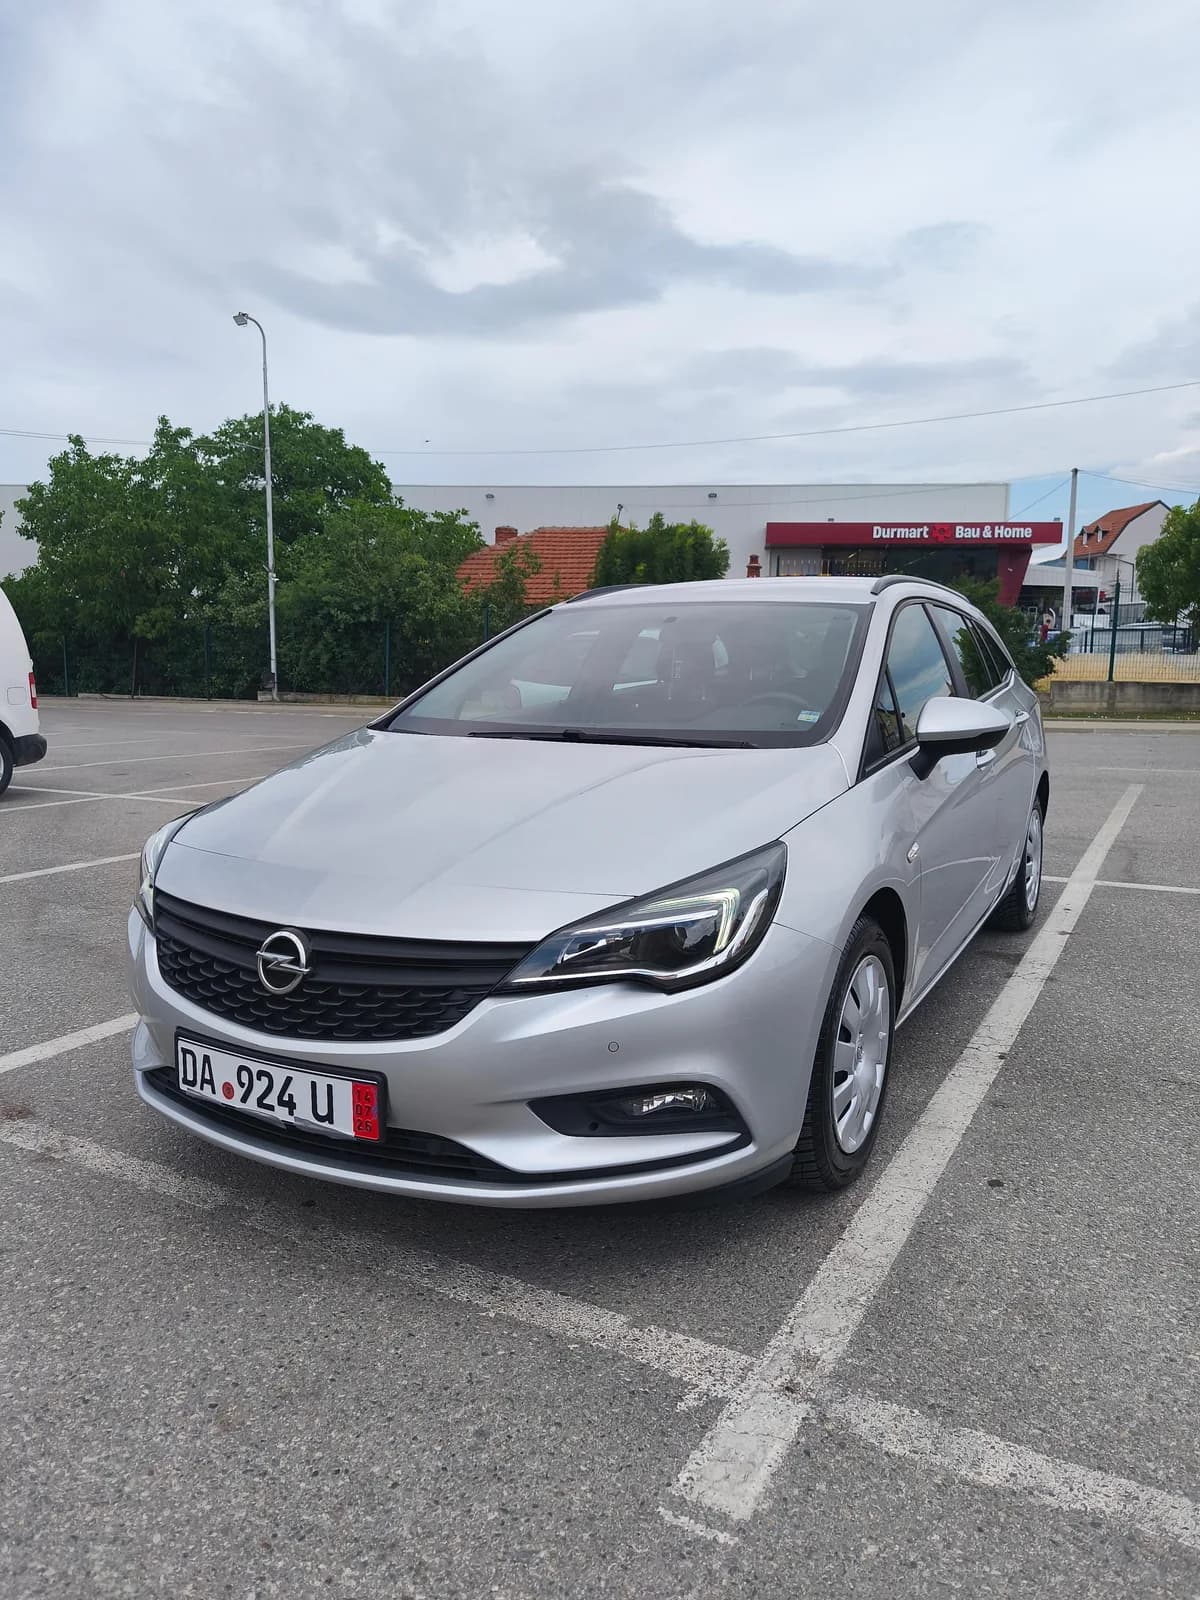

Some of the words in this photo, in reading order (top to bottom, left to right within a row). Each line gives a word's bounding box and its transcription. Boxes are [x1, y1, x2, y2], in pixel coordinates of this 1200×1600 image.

[873, 526, 929, 538] Durmart
[956, 526, 981, 538] Bau
[982, 526, 993, 538] &
[994, 526, 1032, 538] Home
[180, 1046, 217, 1095] DA
[236, 1064, 297, 1117] 924
[310, 1079, 335, 1125] U
